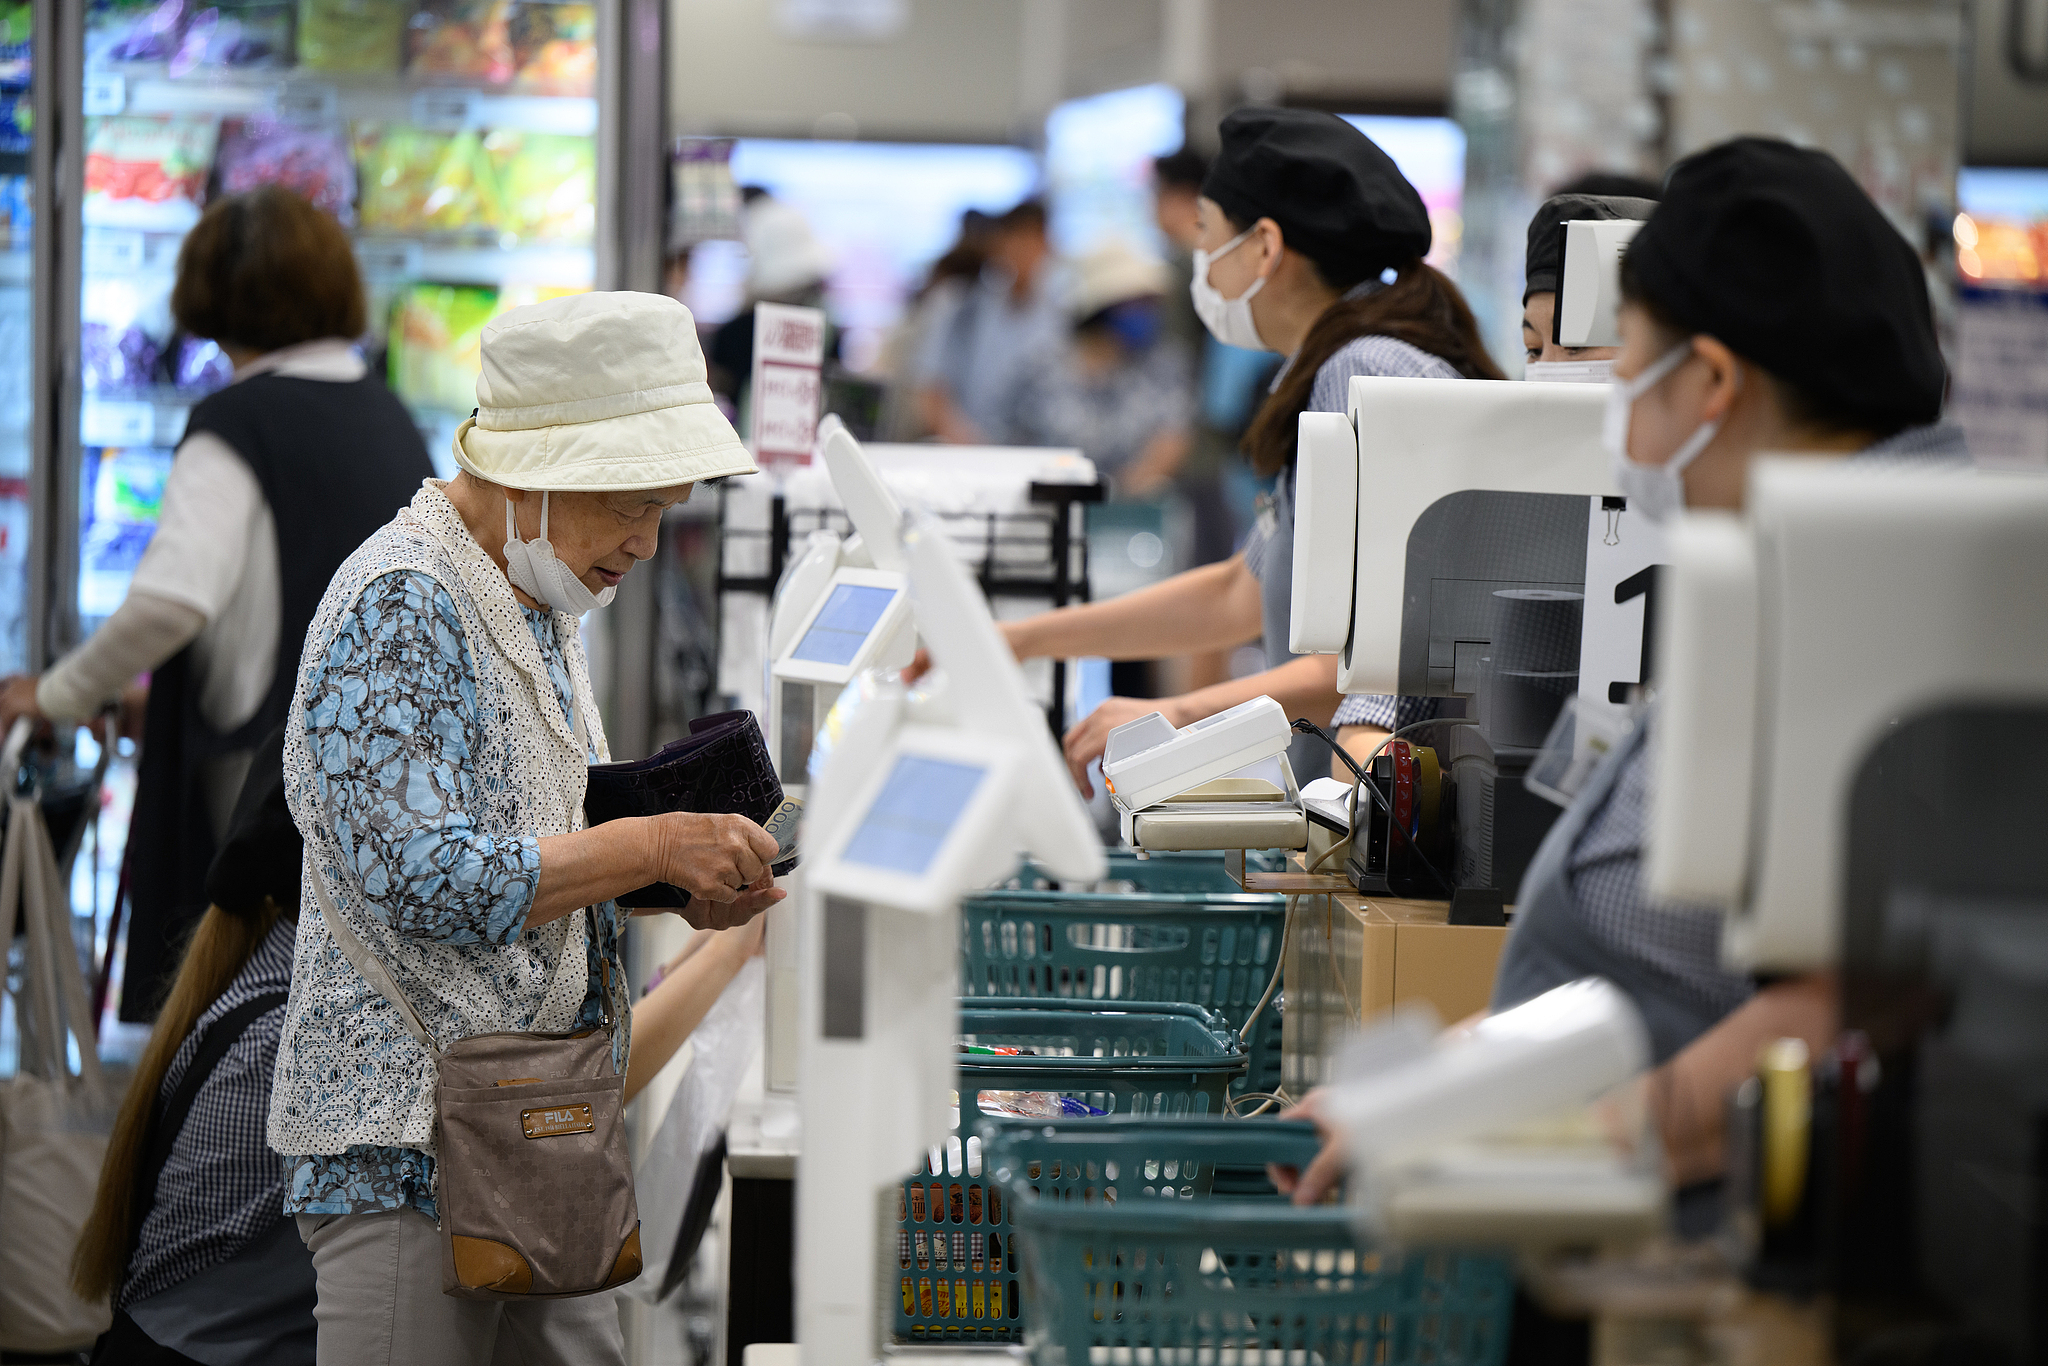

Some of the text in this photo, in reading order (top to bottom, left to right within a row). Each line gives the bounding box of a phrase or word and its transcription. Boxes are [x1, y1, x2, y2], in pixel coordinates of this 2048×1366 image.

[765, 801, 796, 834] 000
[544, 1110, 574, 1124] FILA
[472, 1168, 491, 1177] FILA
